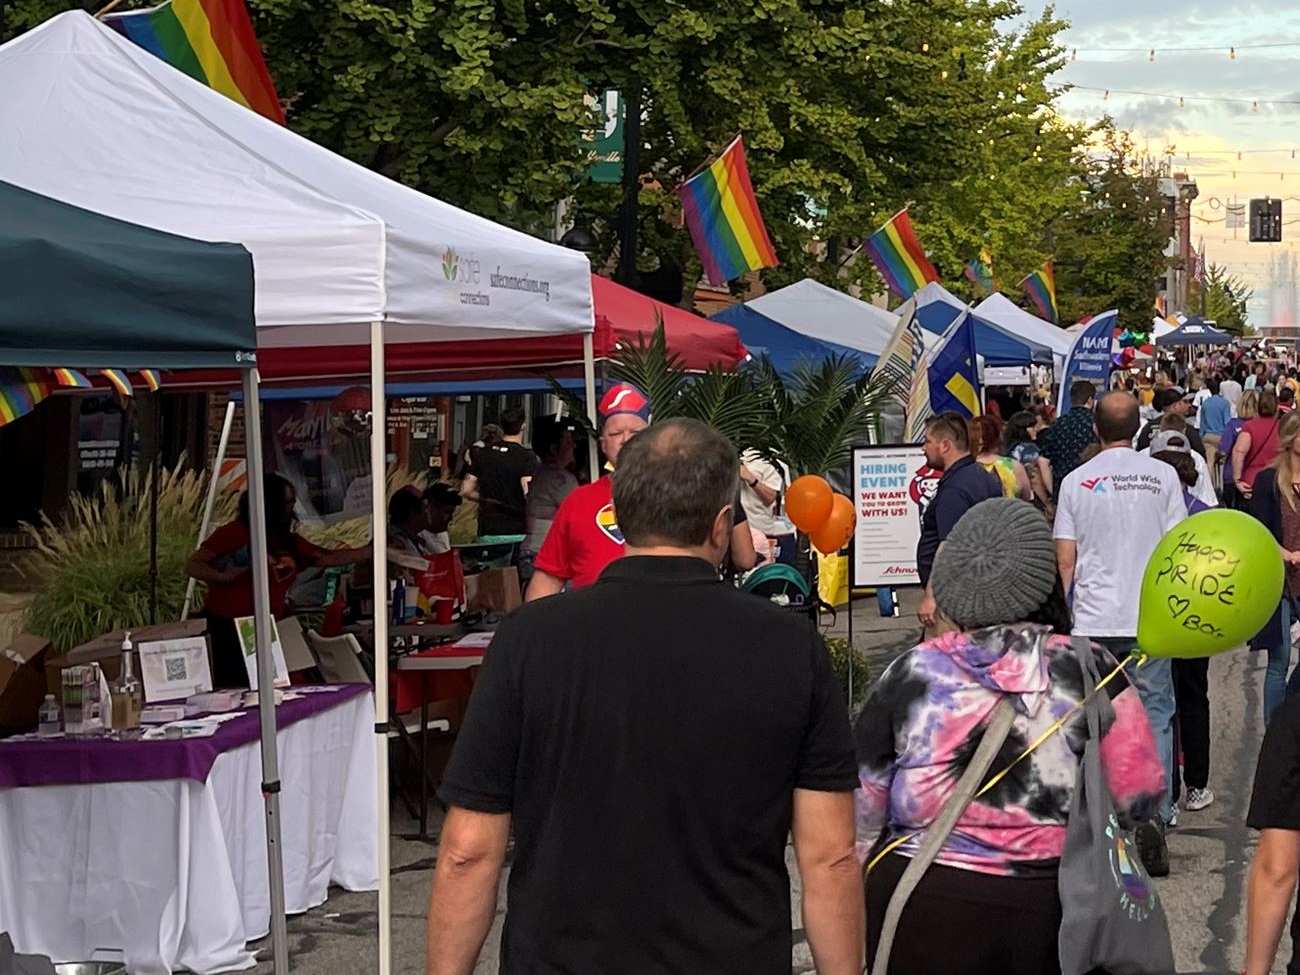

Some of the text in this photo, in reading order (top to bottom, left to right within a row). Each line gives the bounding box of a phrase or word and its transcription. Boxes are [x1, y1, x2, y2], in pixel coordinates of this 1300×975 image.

[1082, 336, 1109, 349] NAMI
[861, 463, 907, 476] HIRING
[861, 476, 908, 488] EVENT
[1111, 474, 1162, 485] World Wide
[1113, 483, 1161, 495] Technology
[861, 491, 908, 500] WE WANT
[861, 507, 908, 518] WITH US!
[1170, 531, 1241, 578] Happy
[1156, 556, 1235, 606] PRIDE
